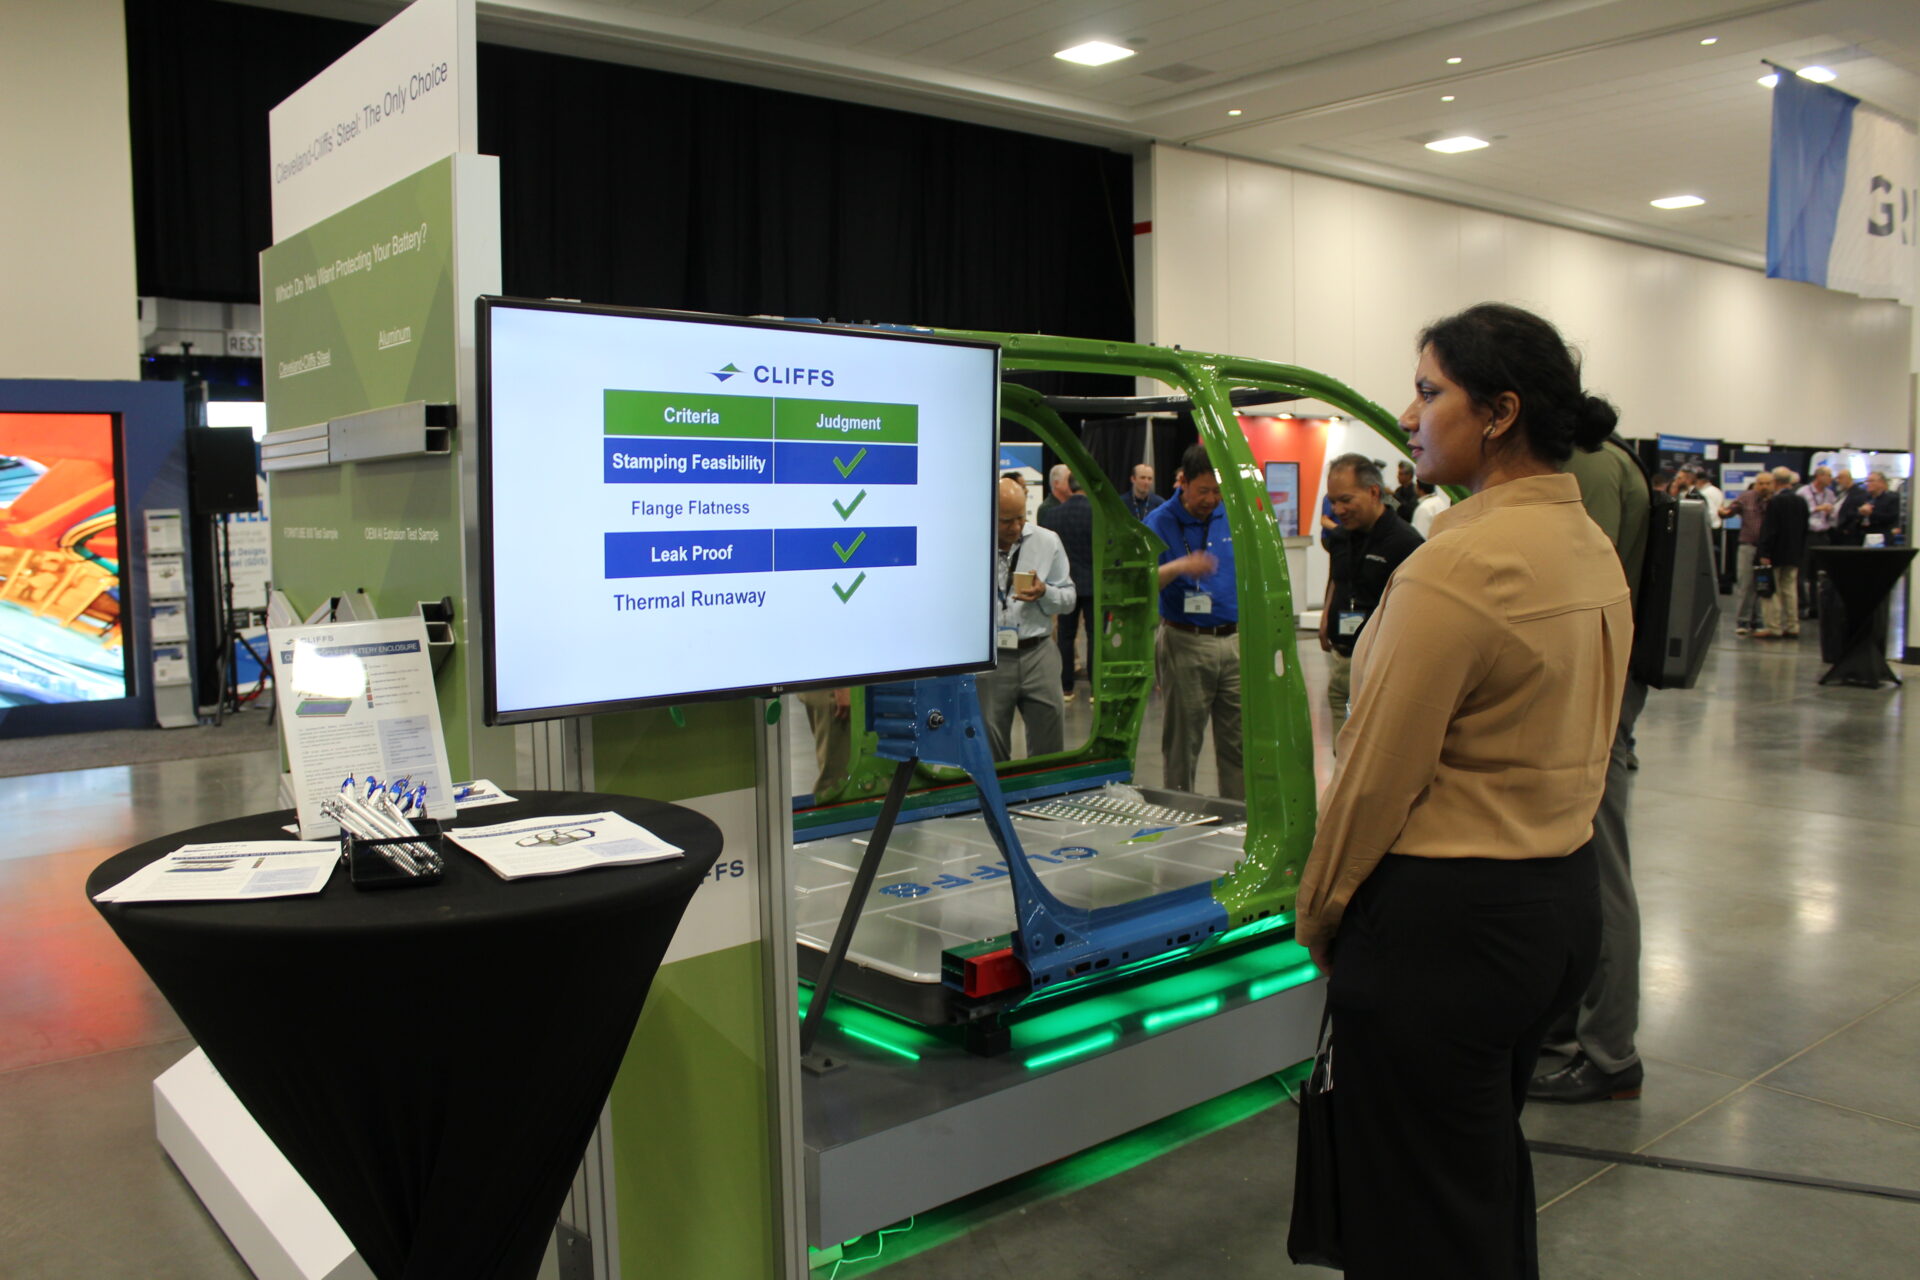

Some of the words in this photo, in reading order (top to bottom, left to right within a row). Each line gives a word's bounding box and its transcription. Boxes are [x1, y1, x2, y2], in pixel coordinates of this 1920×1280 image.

[336, 113, 361, 146] Steel:
[363, 104, 381, 130] The
[384, 85, 406, 117] Only
[409, 62, 448, 100] Choice
[275, 282, 293, 304] Which
[294, 277, 304, 296] Do
[304, 272, 317, 291] You
[317, 264, 335, 287] Want
[335, 252, 372, 279] Protecting
[373, 242, 390, 263] Your
[392, 222, 428, 256] Battery?
[378, 326, 411, 347] Aluminum
[753, 365, 835, 387] CLIFFS
[664, 407, 720, 425] Criteria
[816, 413, 881, 432] Judgment
[612, 452, 687, 473] Stamping
[692, 454, 766, 474] Feasibility
[631, 500, 683, 519] Flange
[689, 500, 750, 516] Flatness
[406, 527, 417, 540] Test
[418, 527, 439, 544] Sample
[651, 546, 688, 562] Leak
[692, 545, 733, 561] Proof
[613, 591, 685, 612] Thermal
[691, 589, 766, 607] Runaway
[379, 642, 418, 653] ENCLOSURE
[879, 846, 1099, 899] CLFFS
